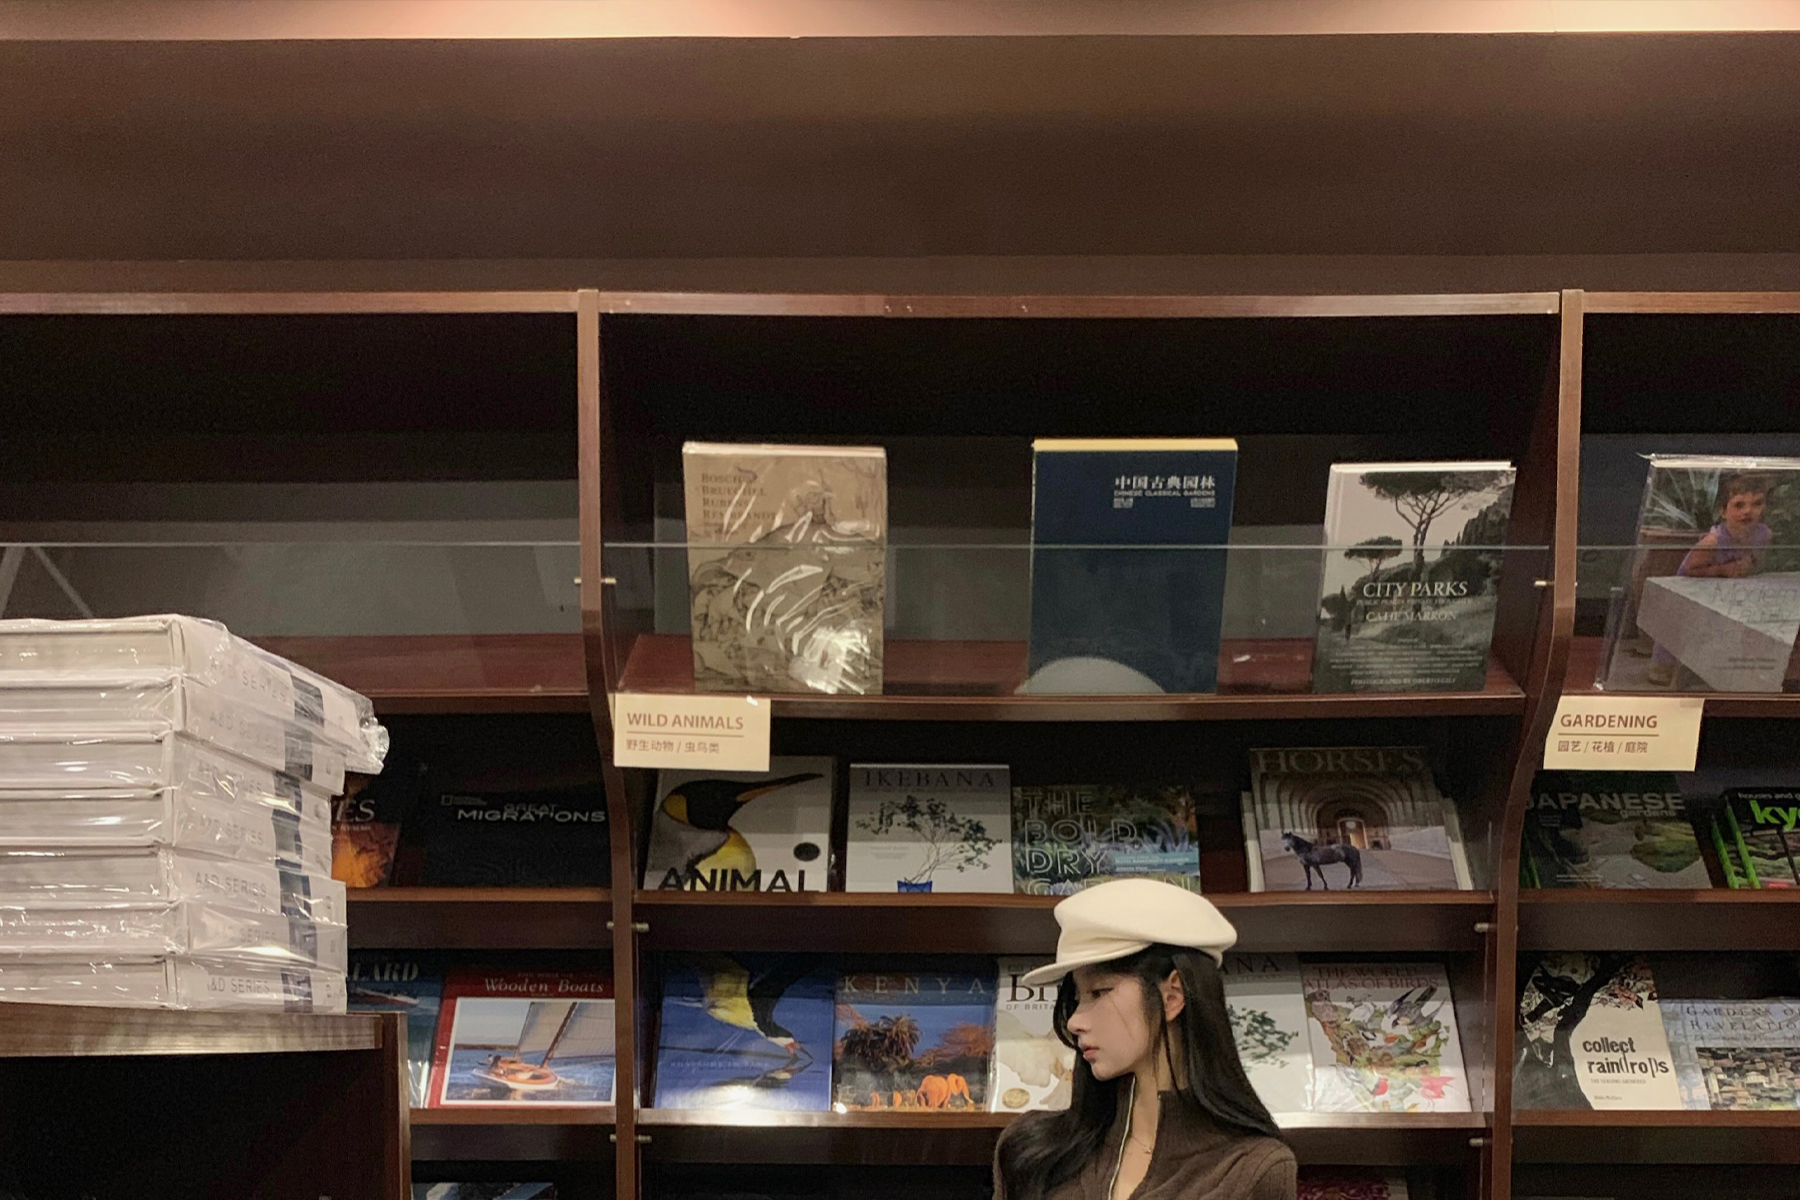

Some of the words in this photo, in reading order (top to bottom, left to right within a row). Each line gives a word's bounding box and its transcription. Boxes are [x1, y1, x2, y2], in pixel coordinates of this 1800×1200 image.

[1115, 475, 1215, 489] 中国古典园林
[1363, 582, 1407, 598] CITY
[1410, 581, 1468, 597] PARKS
[627, 713, 668, 727] WILD
[672, 715, 744, 730] ANIMALS
[1560, 714, 1658, 729] GARDENING
[626, 739, 673, 752] 野生动物
[1558, 740, 1581, 752] 园艺
[1592, 741, 1614, 753] 花植
[1625, 742, 1648, 753] 庭院
[866, 770, 995, 788] IKEBANA
[1022, 790, 1094, 816] THE
[1620, 809, 1677, 819] gardens
[1748, 799, 1800, 832] ky
[1026, 848, 1108, 875] DRY
[224, 876, 267, 898] SERIES
[658, 867, 810, 893] ANIMAL
[231, 978, 271, 995] SERIES
[485, 977, 550, 993] Wooden
[558, 978, 604, 993] Boats
[844, 975, 986, 995] KENYA
[1362, 978, 1381, 989] OF
[1389, 978, 1440, 988] BIRDS
[1583, 1037, 1636, 1053] collect
